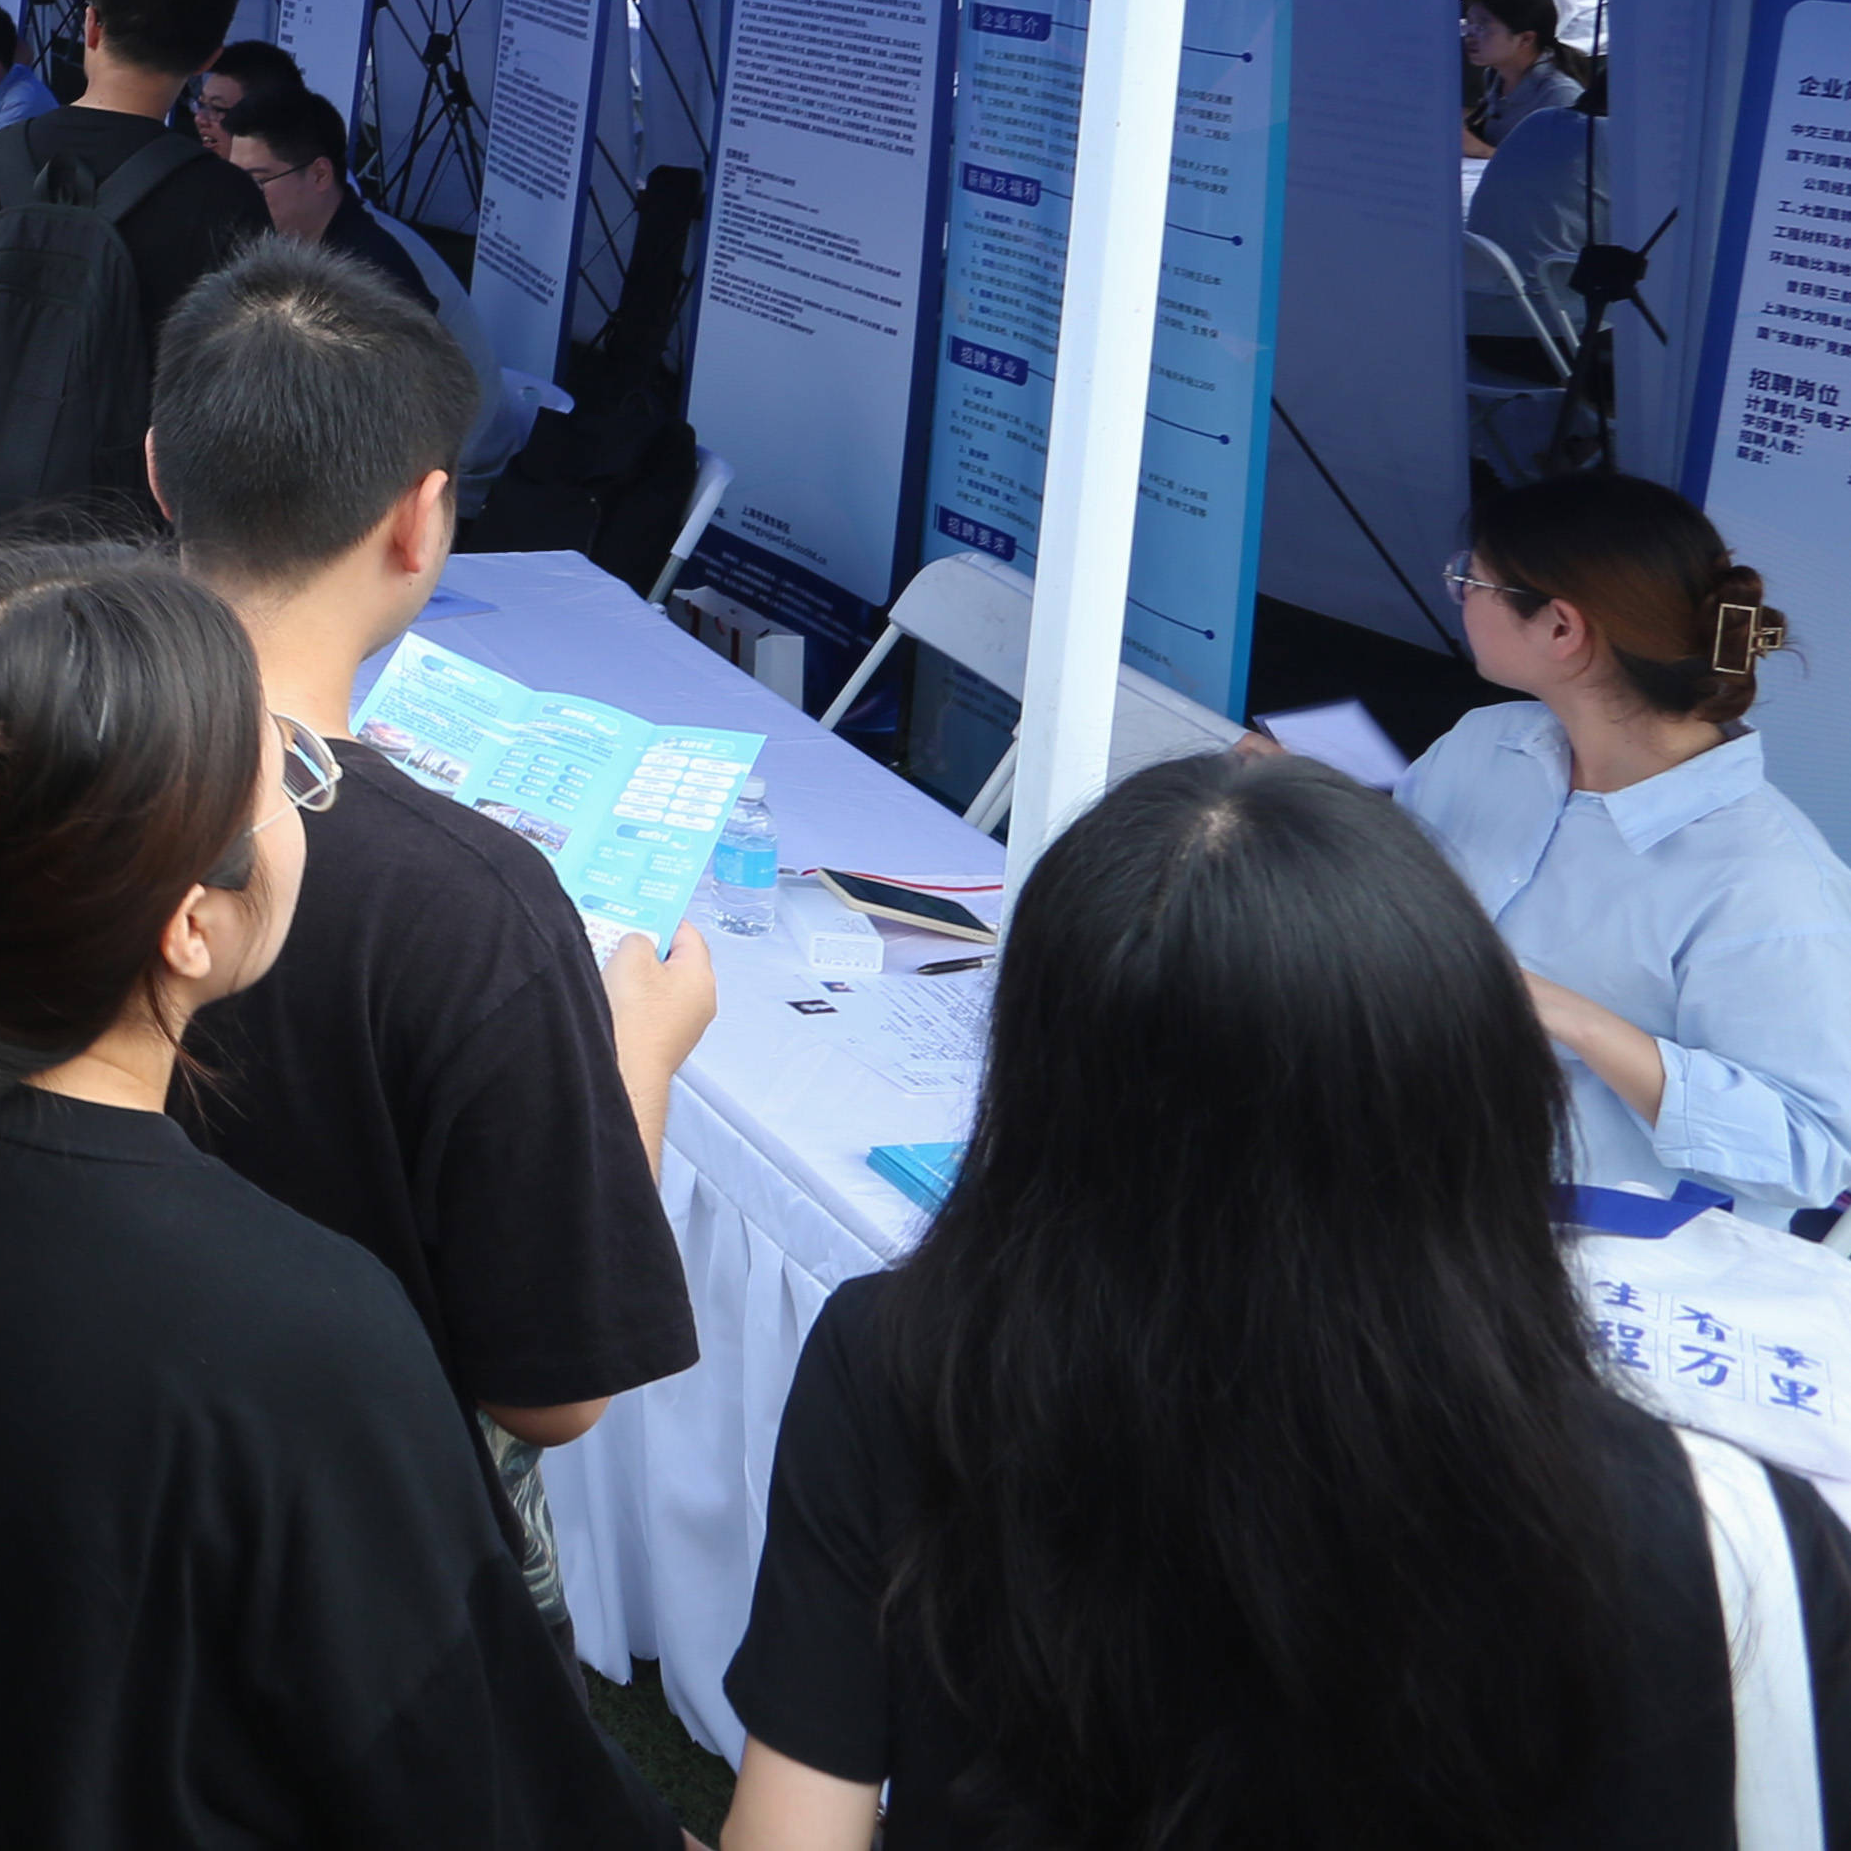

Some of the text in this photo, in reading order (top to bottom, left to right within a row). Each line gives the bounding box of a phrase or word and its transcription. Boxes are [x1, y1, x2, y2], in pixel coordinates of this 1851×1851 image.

[980, 9, 1040, 37] 企业简介
[1797, 75, 1851, 103] 企业
[967, 167, 1038, 203] 薪酬及福利
[959, 344, 1018, 380] 招聘专业
[1749, 367, 1841, 408] 招聘岗位
[1745, 394, 1851, 432] 计算机与电子
[946, 515, 1007, 555] 招聘要求
